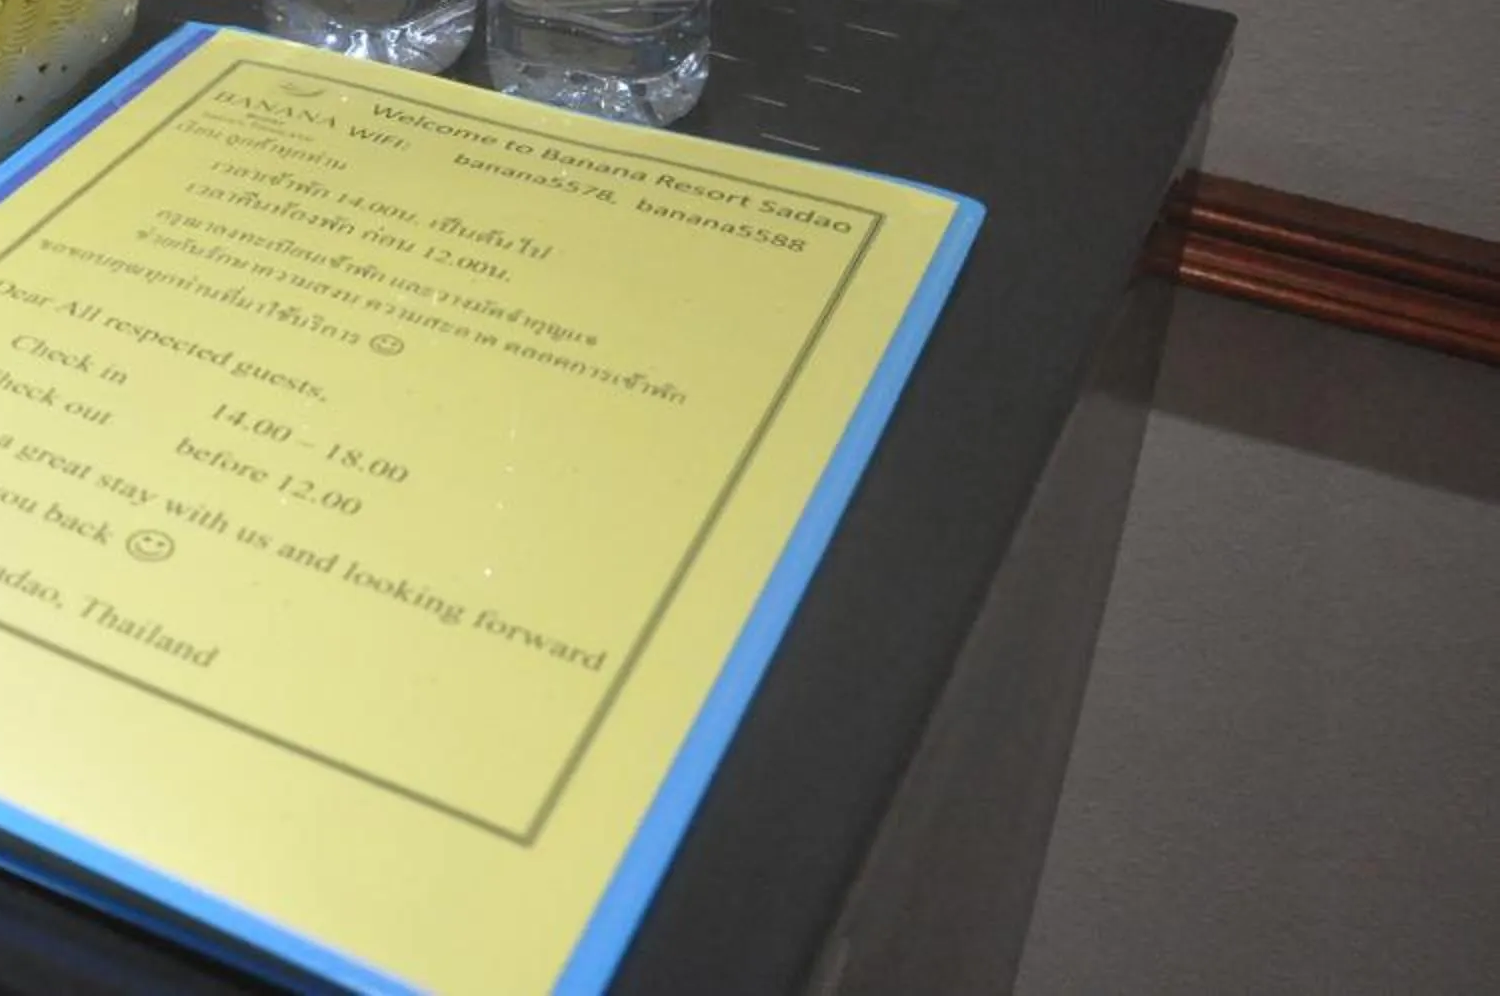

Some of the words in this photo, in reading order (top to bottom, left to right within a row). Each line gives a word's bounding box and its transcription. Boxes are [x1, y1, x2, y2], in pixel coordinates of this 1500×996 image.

[214, 91, 335, 128] BANANA
[373, 104, 497, 144] Welcome
[505, 140, 534, 154] to
[541, 148, 647, 181] Banana
[655, 174, 751, 208] Resort
[759, 200, 852, 233] Sadao
[636, 198, 806, 252] banana5588
[62, 301, 102, 321] All
[104, 317, 233, 366] respected
[11, 335, 91, 373] Check
[100, 368, 127, 385] in
[212, 404, 292, 442] 14.00
[326, 444, 409, 483] 18.00
[64, 403, 112, 425] out
[176, 437, 268, 482] before
[278, 475, 362, 515] 12.00
[15, 445, 92, 479] great
[100, 475, 156, 506] stay
[166, 499, 228, 534] with
[237, 527, 268, 549] us
[277, 545, 339, 573] and
[343, 561, 465, 624] looking
[473, 611, 607, 671] forward
[44, 503, 108, 545] back
[80, 598, 220, 668] Thailand
